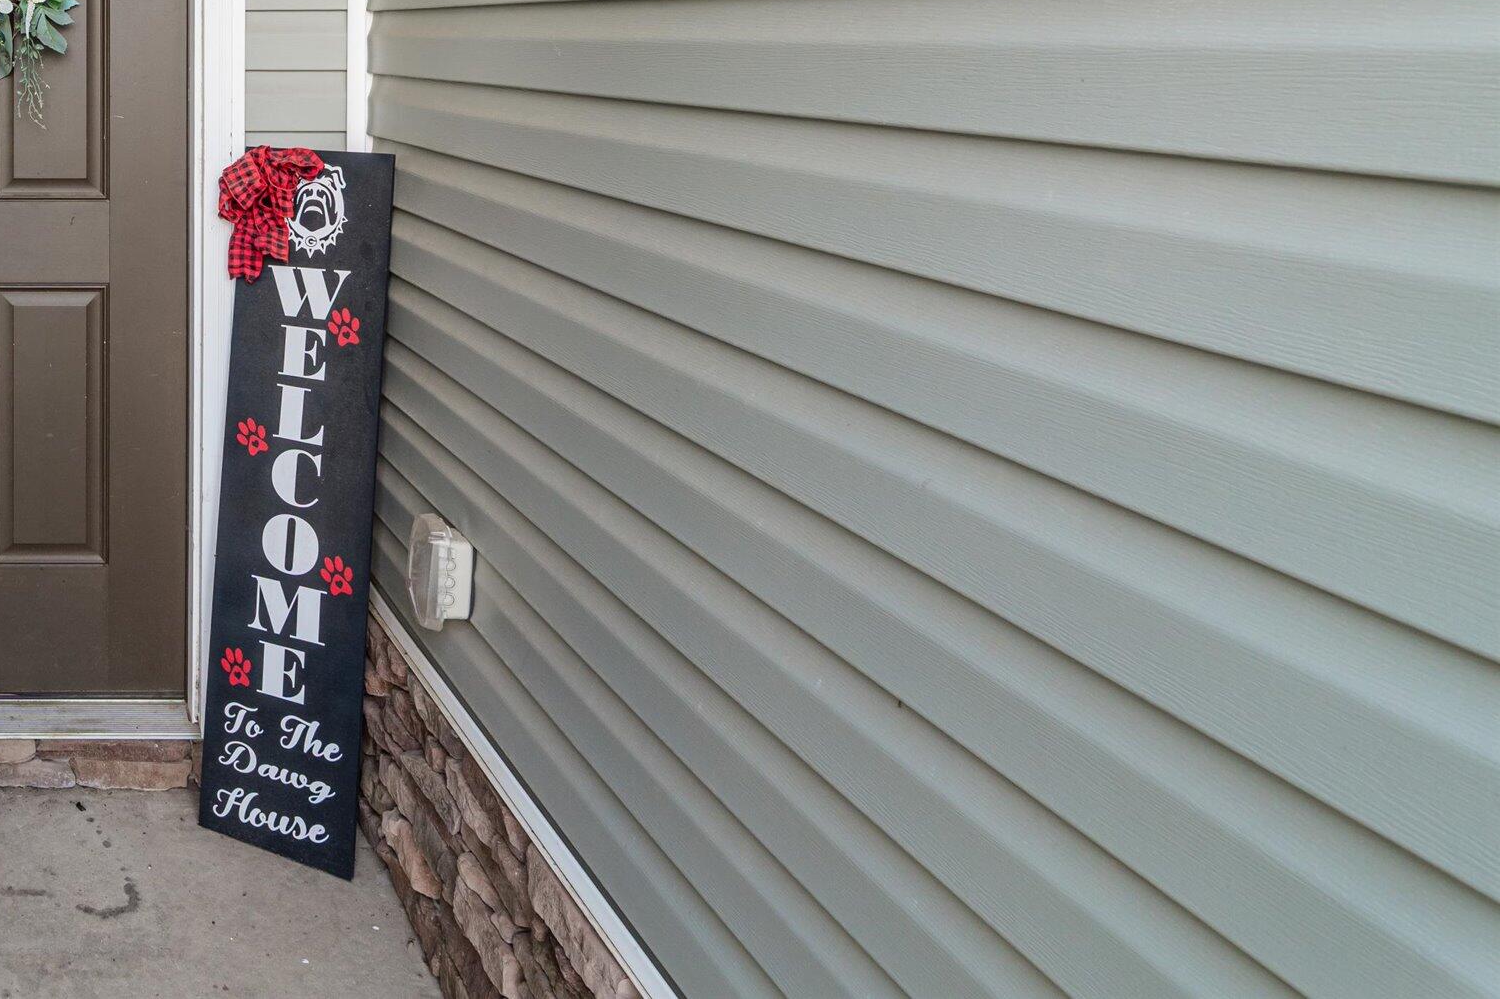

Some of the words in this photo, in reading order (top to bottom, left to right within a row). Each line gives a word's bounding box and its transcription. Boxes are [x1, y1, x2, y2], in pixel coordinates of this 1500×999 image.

[305, 236, 318, 247] G
[247, 265, 351, 705] WELCOME
[224, 702, 264, 738] To
[280, 715, 343, 762] The
[218, 741, 336, 804] Dawg
[212, 787, 330, 844] House
